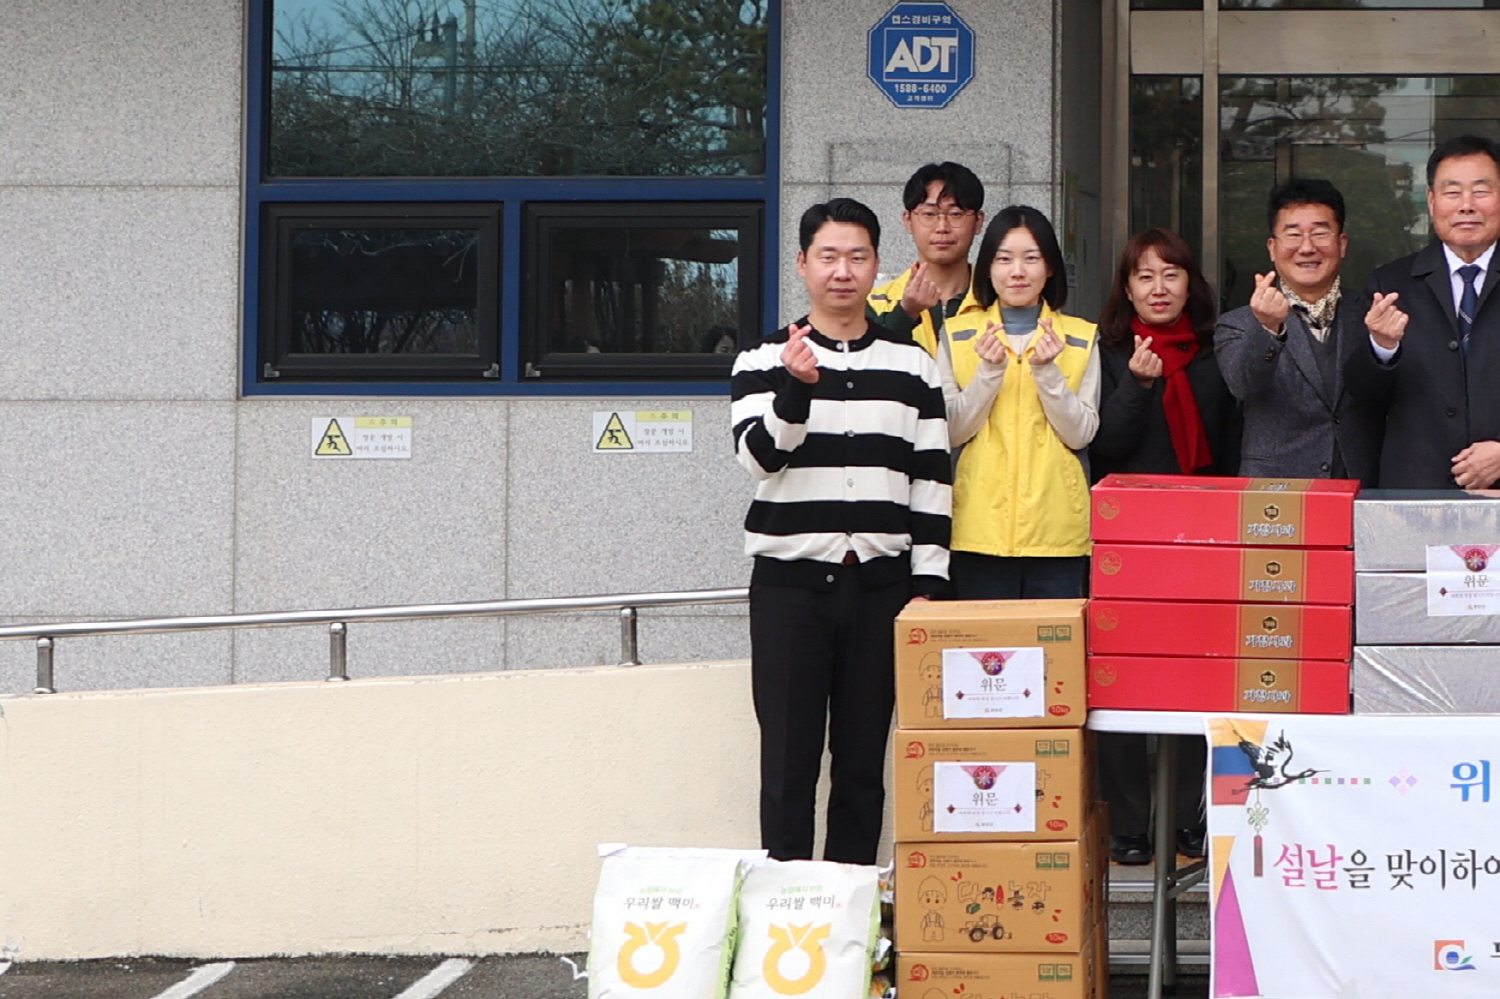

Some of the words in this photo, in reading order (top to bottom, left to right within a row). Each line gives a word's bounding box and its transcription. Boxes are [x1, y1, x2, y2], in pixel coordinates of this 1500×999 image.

[884, 36, 958, 73] ADT
[894, 83, 947, 93] 1588-6400
[1464, 574, 1490, 588] 위문
[980, 677, 1007, 692] 위문
[971, 792, 999, 806] 위문
[1273, 843, 1375, 890] 설날을
[623, 896, 664, 910] 우리쌀
[668, 896, 695, 910] 백미
[766, 896, 806, 910] 우리쌀
[809, 894, 836, 909] 백미
